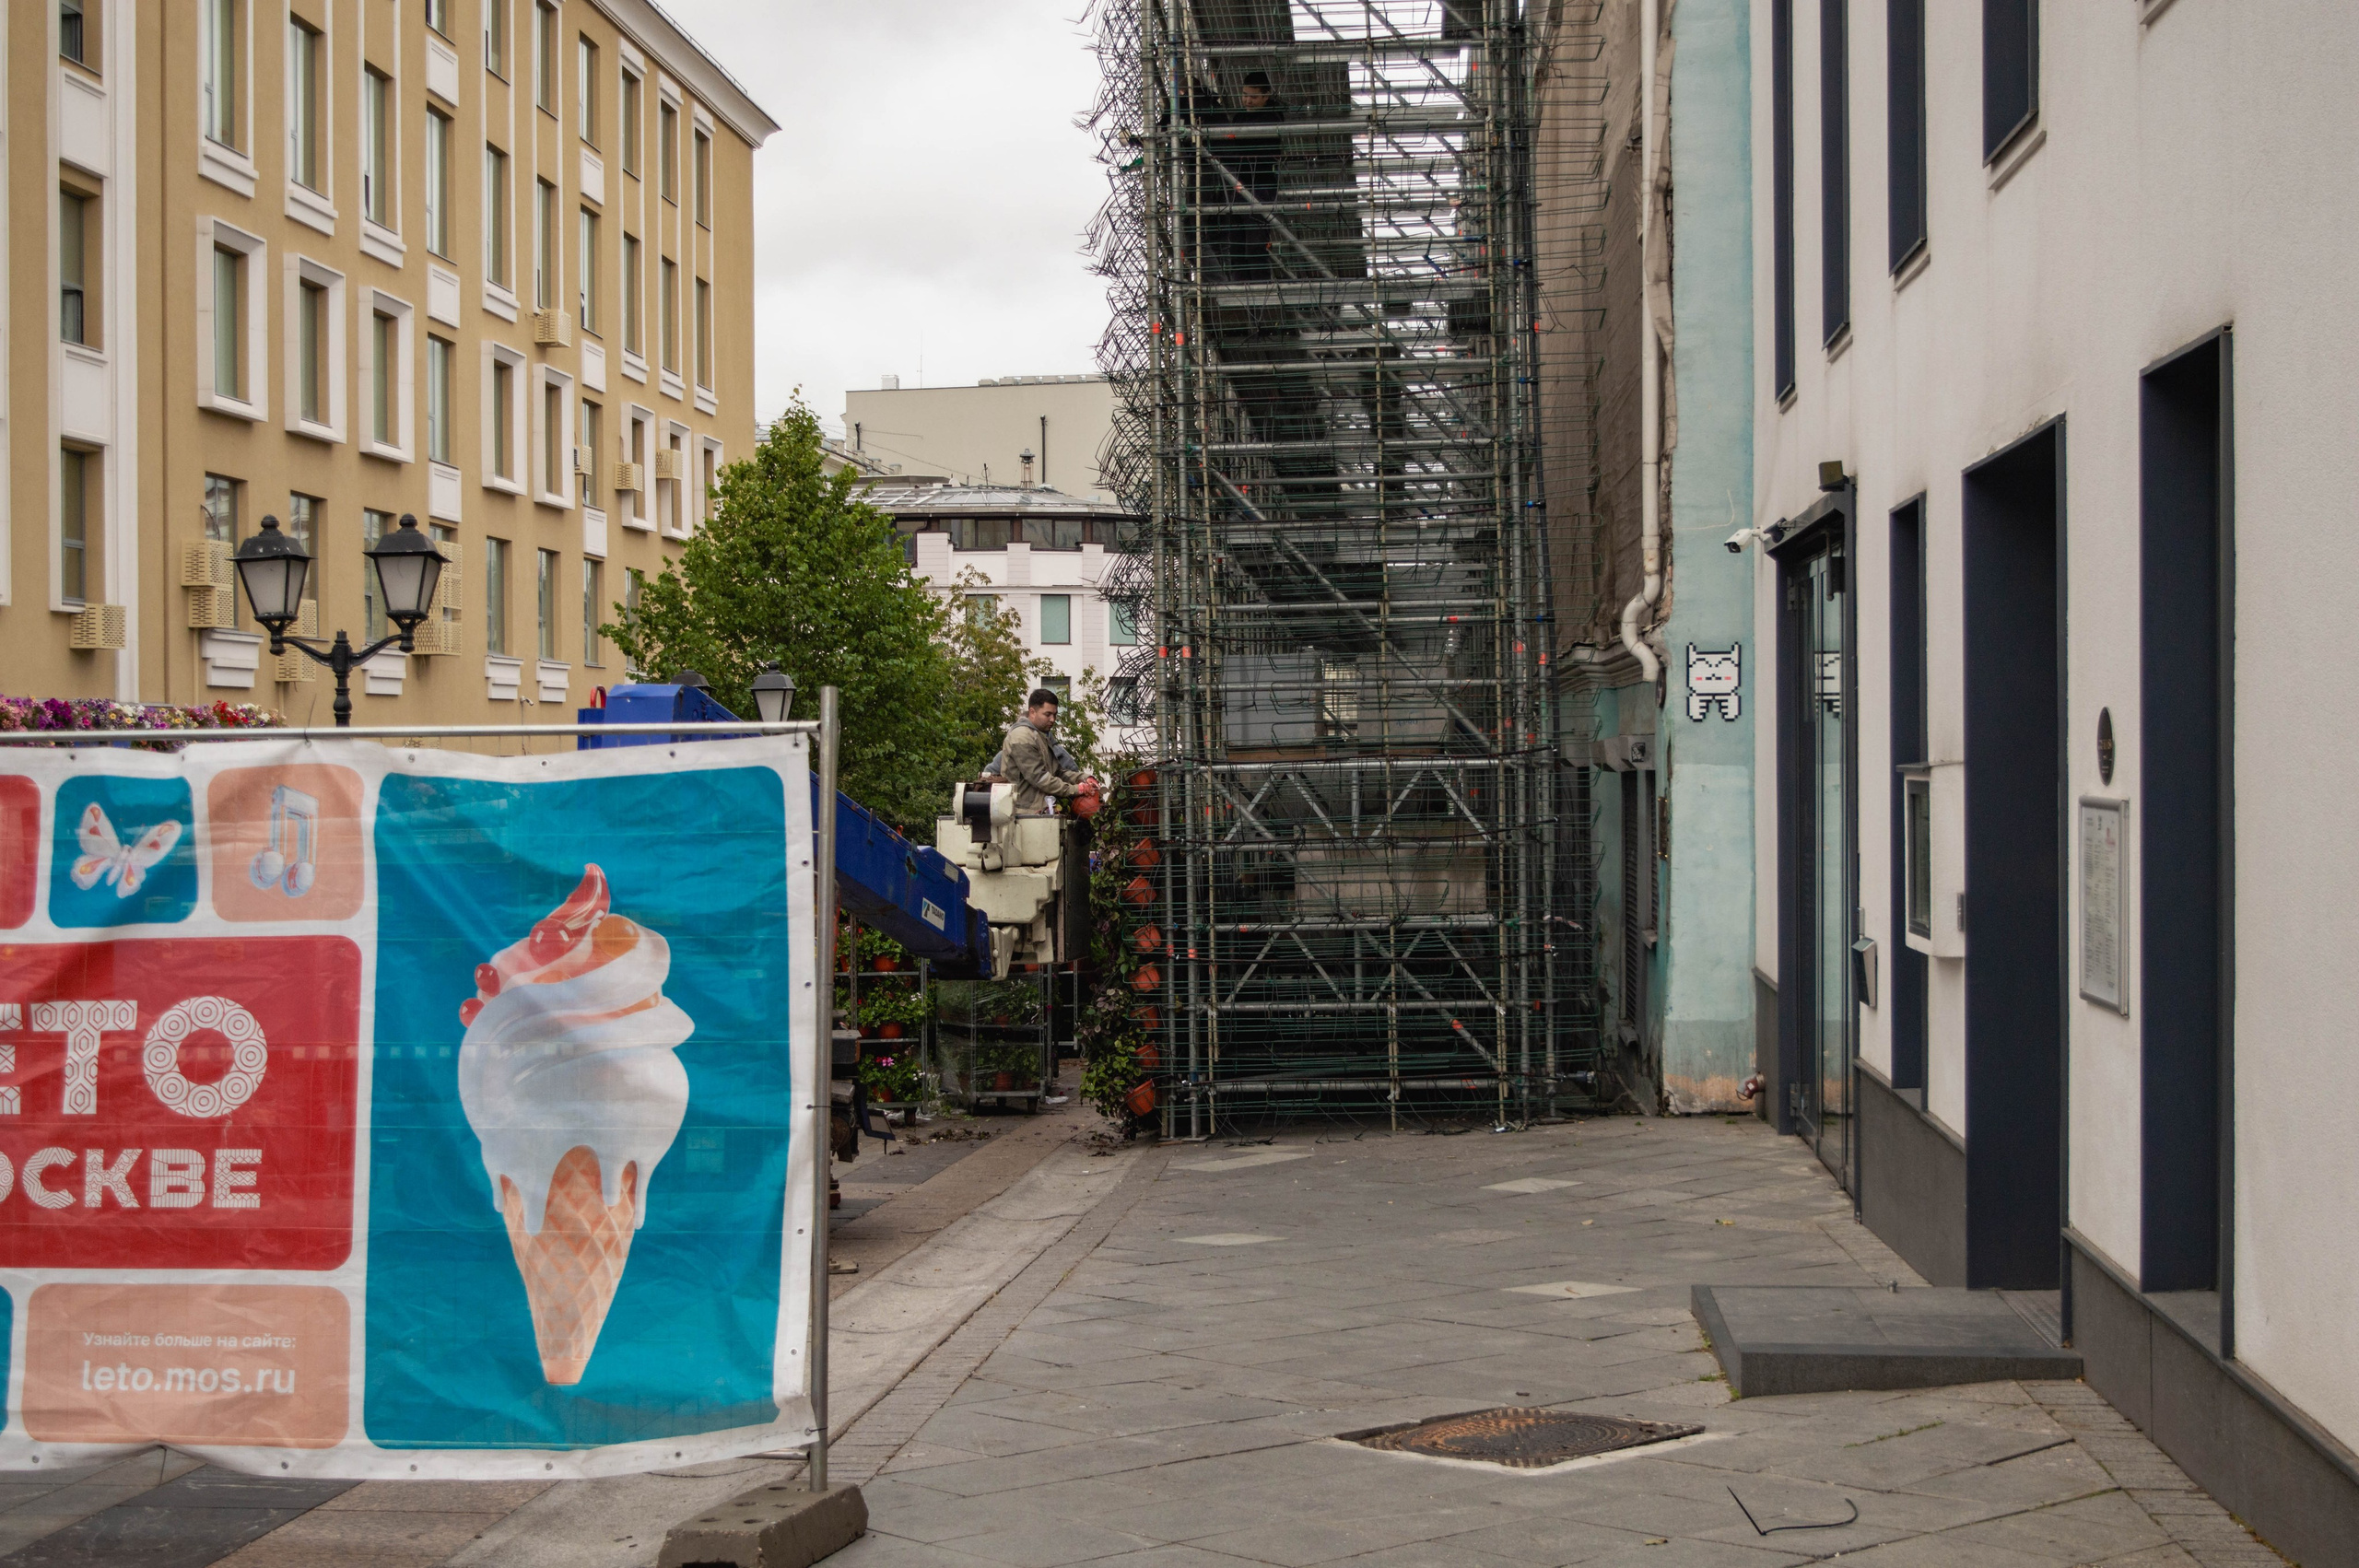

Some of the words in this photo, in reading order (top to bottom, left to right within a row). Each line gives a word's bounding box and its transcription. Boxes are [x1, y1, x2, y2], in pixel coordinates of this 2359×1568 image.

[0, 996, 268, 1118] ТО
[0, 1147, 263, 1209] СКВЕ
[83, 1332, 151, 1347] Узнайте
[154, 1333, 213, 1347] больше
[217, 1335, 239, 1348] на
[241, 1333, 297, 1349] сайте:
[82, 1360, 296, 1394] leto.mos.ru
